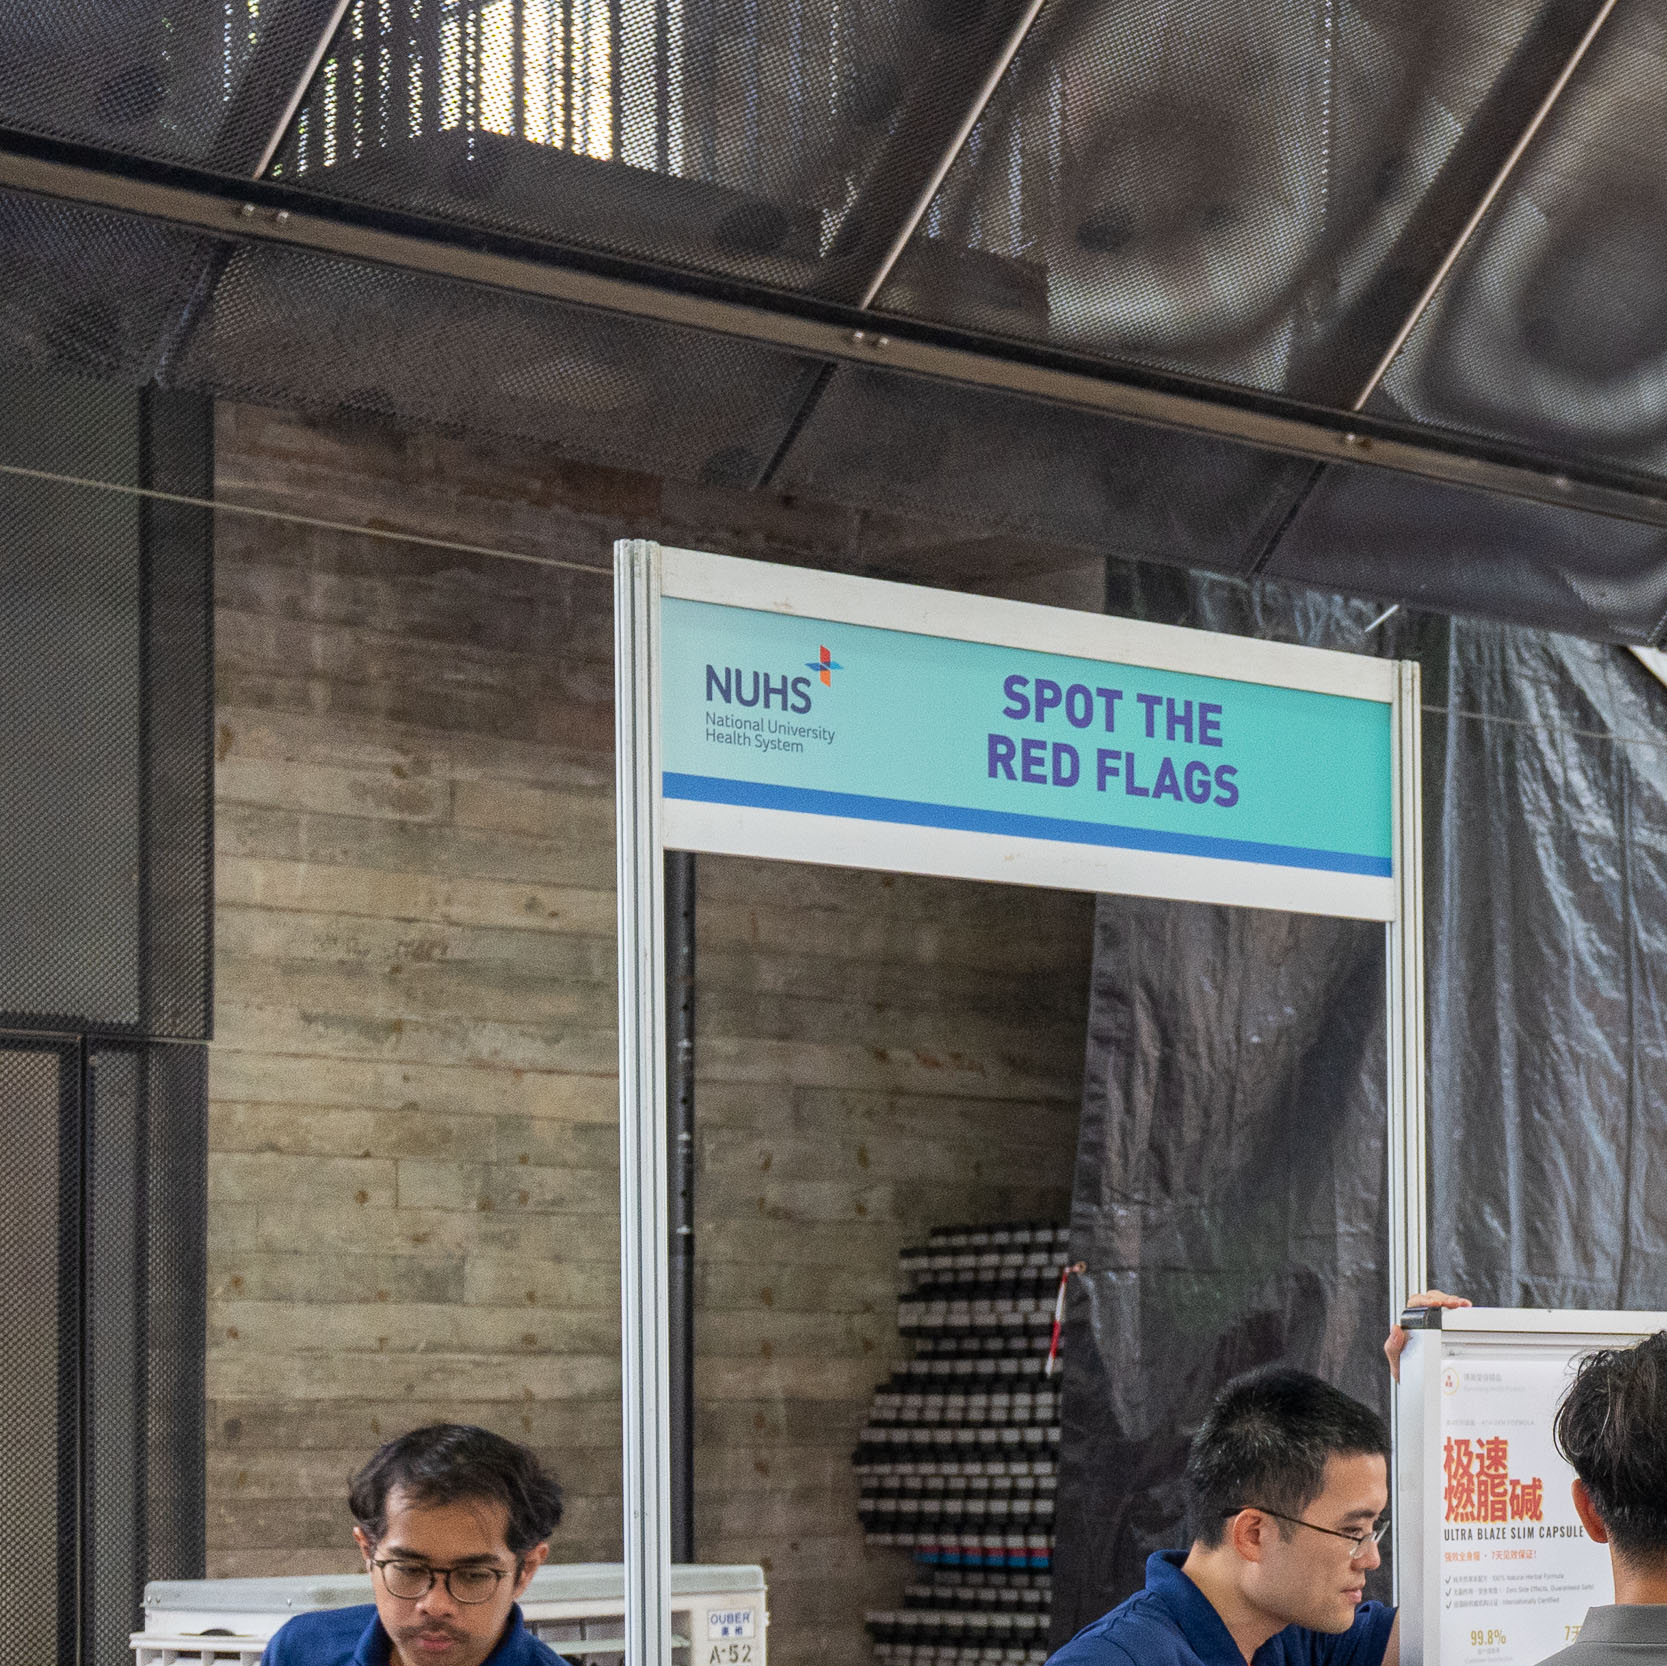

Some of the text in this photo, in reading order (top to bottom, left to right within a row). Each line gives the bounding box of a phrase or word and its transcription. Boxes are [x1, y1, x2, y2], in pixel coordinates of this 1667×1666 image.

[706, 664, 812, 714] NUHS
[706, 711, 836, 745] National University
[1002, 674, 1224, 748] SPOT THE
[706, 728, 804, 753] Health System
[987, 734, 1240, 808] RED FLAGS
[1443, 1435, 1509, 1479] 极速
[1443, 1476, 1544, 1523] 燃脂碱
[1444, 1525, 1585, 1541] ULTRA BLAZE SLIM CAPSULE
[710, 1612, 750, 1625] OUBER
[1470, 1629, 1507, 1647] 99.8%
